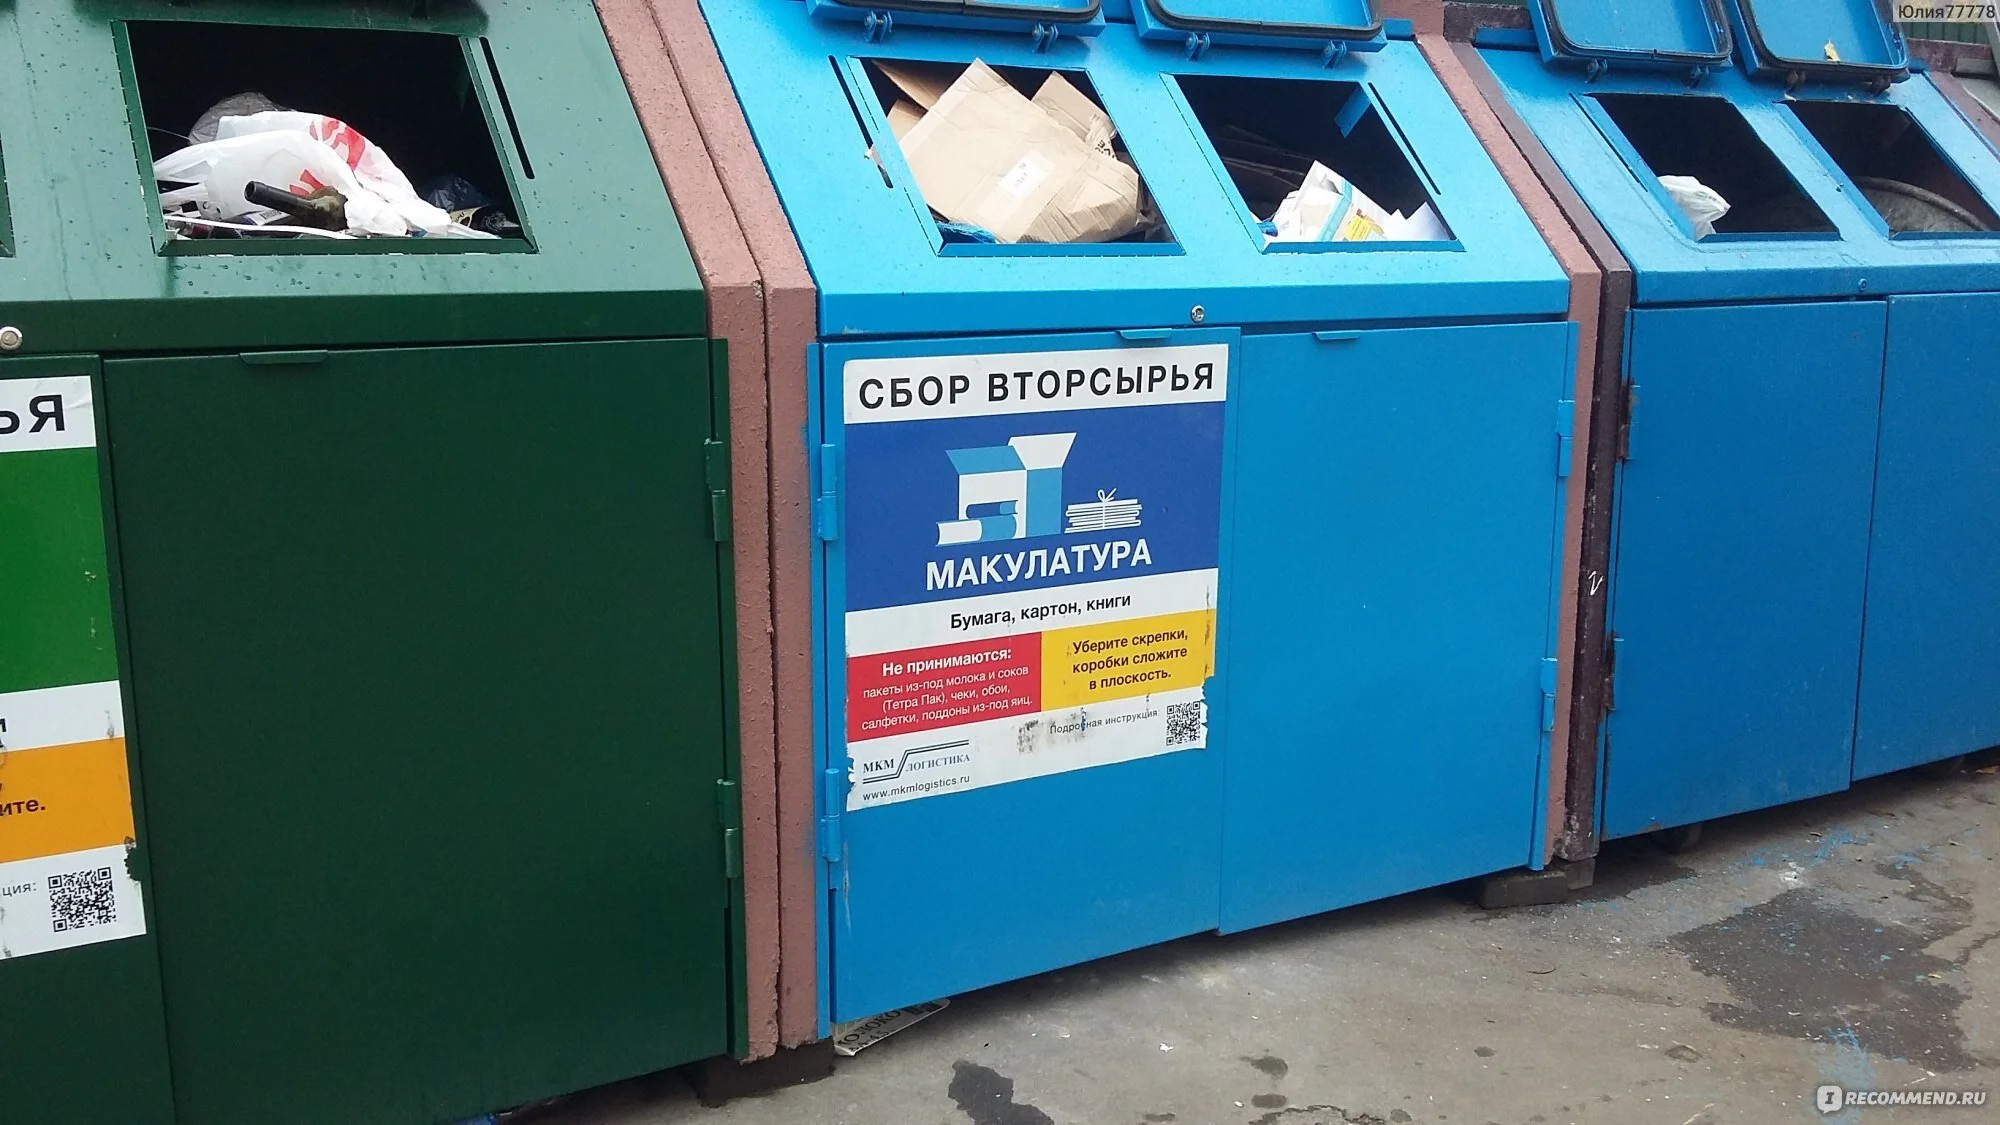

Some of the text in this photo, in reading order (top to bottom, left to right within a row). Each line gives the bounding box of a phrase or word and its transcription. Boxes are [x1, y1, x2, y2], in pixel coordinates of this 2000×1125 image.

[859, 362, 1214, 409] СБОР ВТОРСЫРЬЯ
[926, 538, 1153, 591] МАКУЛАТУРА
[950, 595, 1131, 630] Бумага, картон, книги
[1072, 629, 1189, 656] Уберите скрепки,
[882, 648, 1012, 677] Не принимаются:
[1072, 647, 1188, 674] коробки сложите
[863, 665, 1029, 699] пакеты из-под молока и соков
[1089, 669, 1172, 690] в плоскость.
[882, 683, 1011, 713] (Тетра Пак), чеки, обои,
[861, 696, 1033, 731] салфетки, поддоны из-под яиц.
[862, 758, 895, 774] МКМ
[905, 753, 971, 772] ЛОГИСТИКА
[862, 774, 971, 801] www.mkmlogistics.ru
